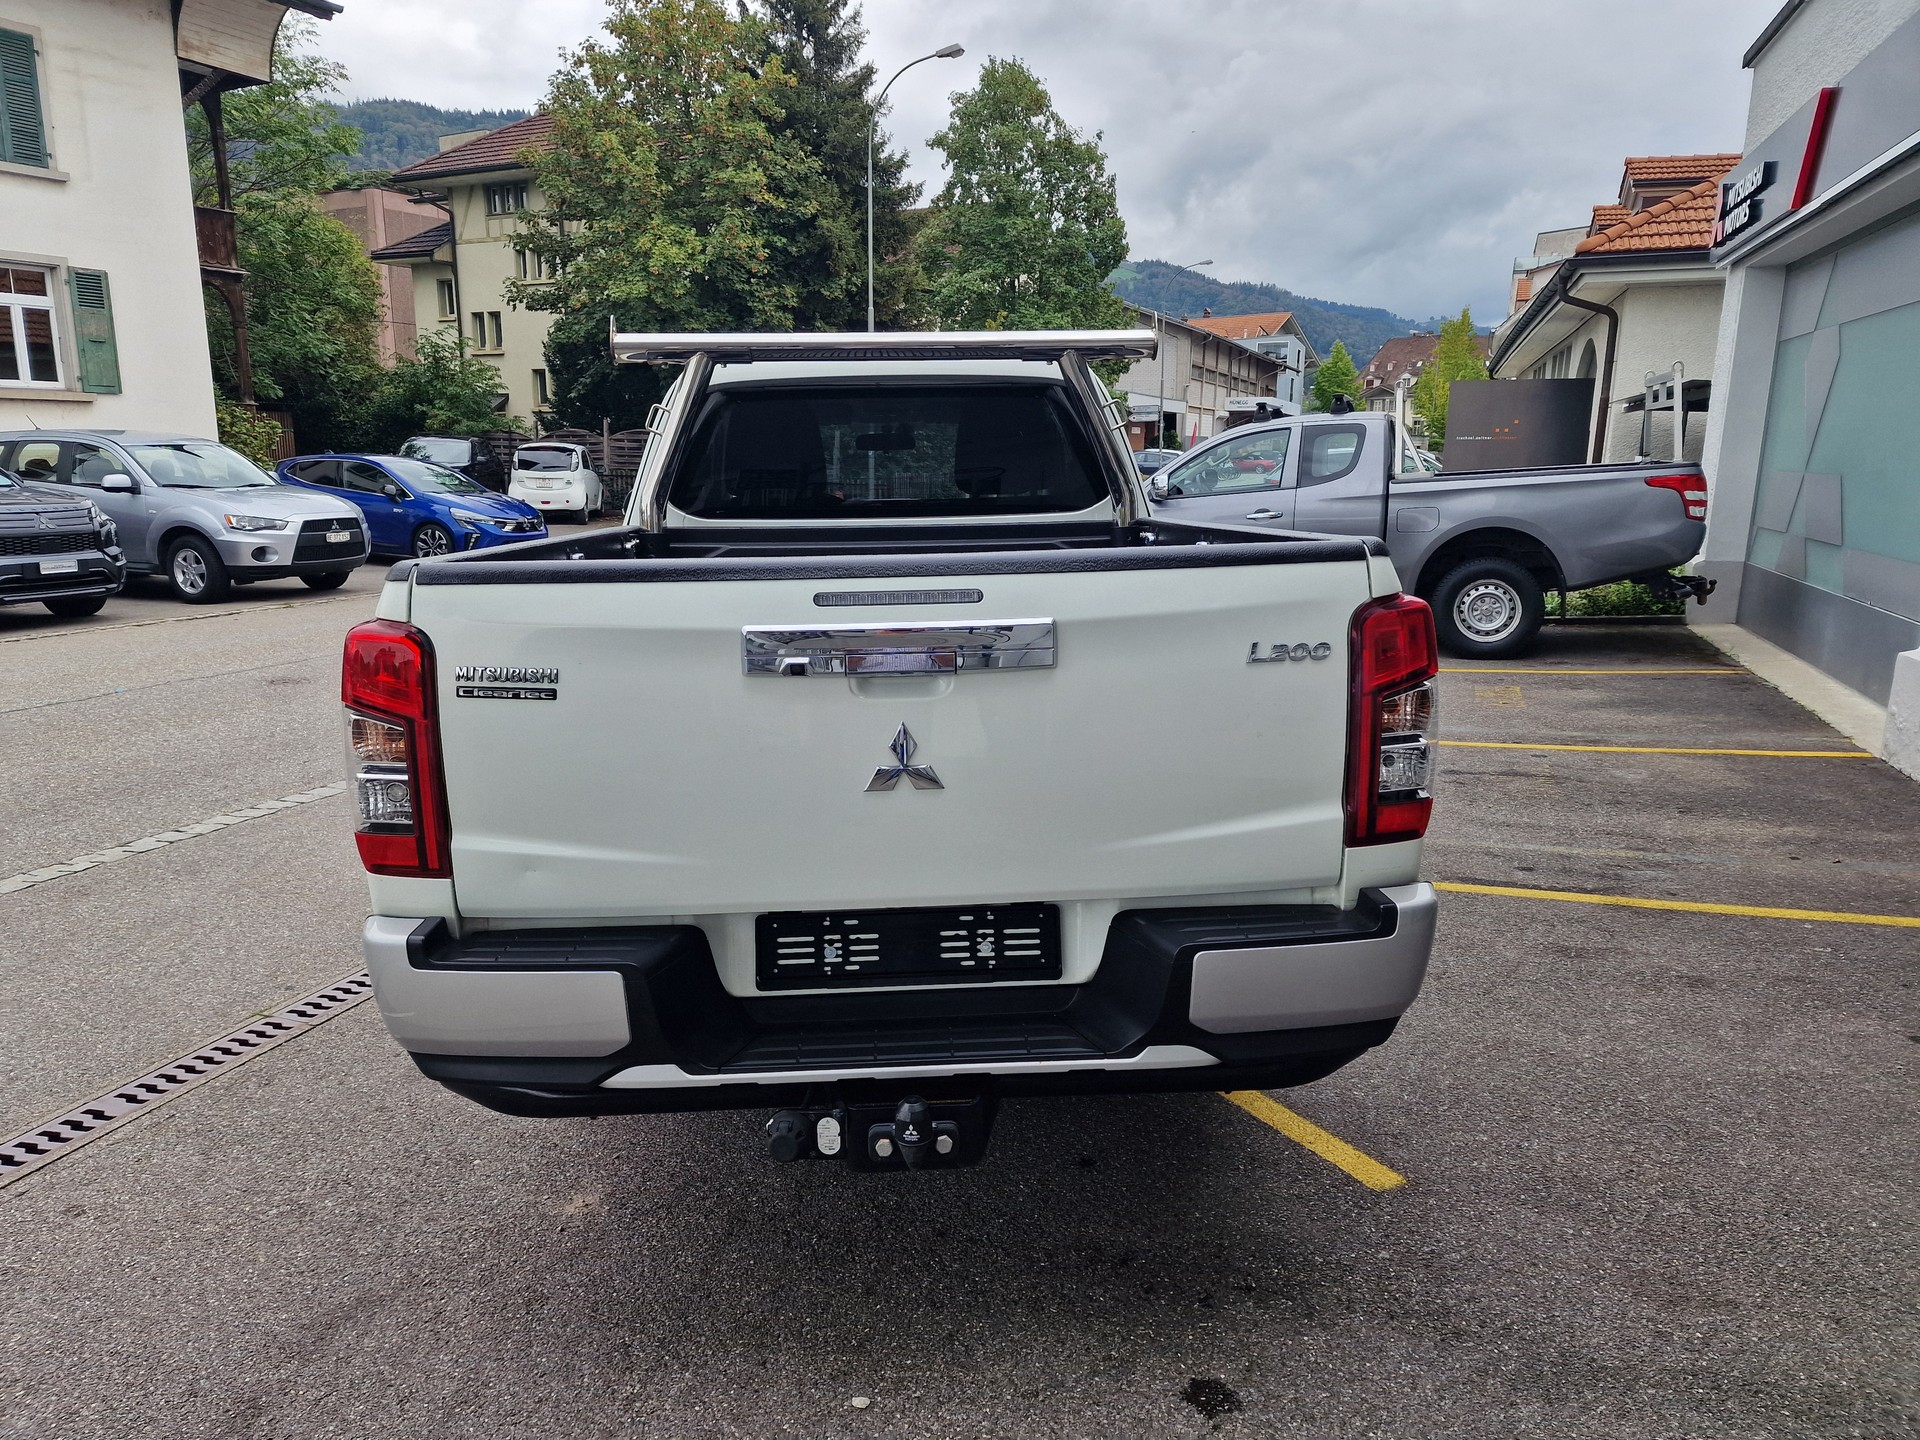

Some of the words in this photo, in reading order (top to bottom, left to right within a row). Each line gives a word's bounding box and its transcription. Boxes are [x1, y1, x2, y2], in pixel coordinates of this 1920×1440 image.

[1727, 161, 1764, 211] MITSUBISHI
[1723, 199, 1750, 237] MOTORS
[1246, 641, 1331, 664] L200
[455, 666, 559, 684] MITSUBISHI
[458, 687, 554, 699] ClearTec
